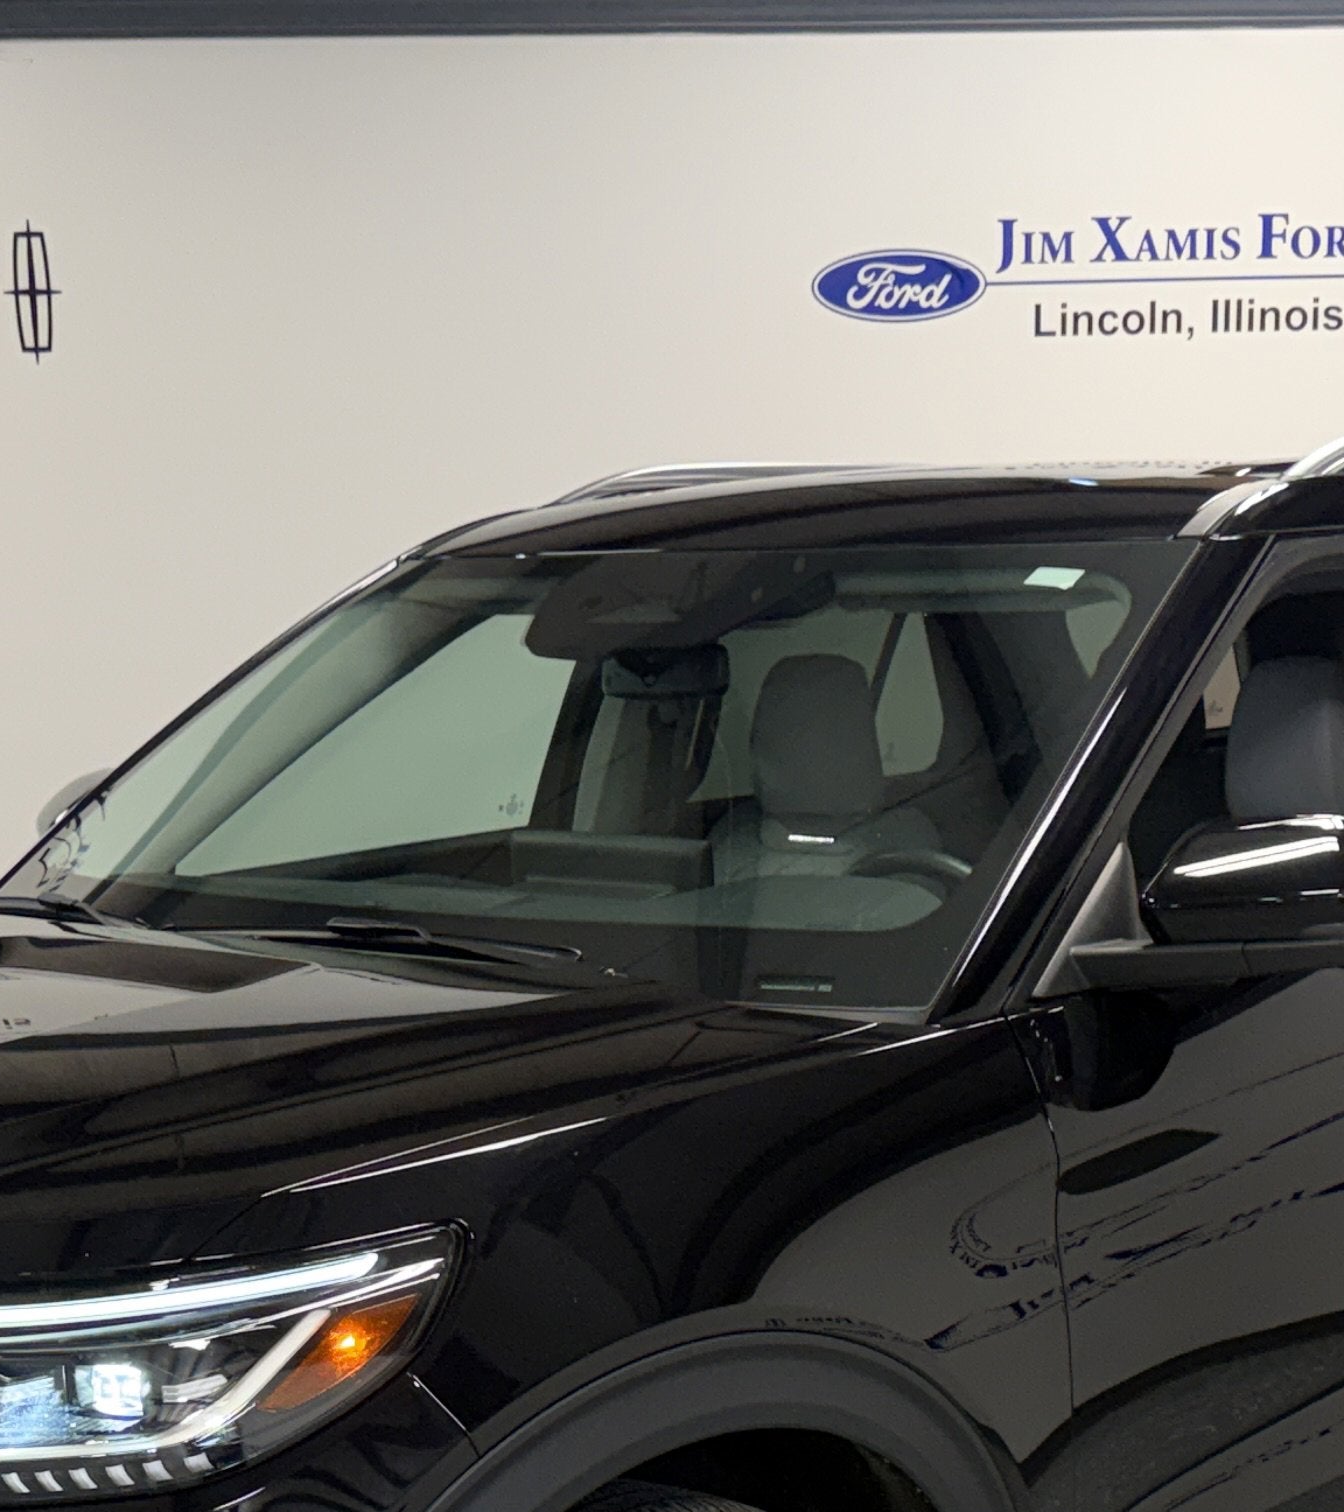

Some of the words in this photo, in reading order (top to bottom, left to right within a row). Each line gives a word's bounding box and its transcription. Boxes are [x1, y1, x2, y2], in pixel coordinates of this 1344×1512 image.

[846, 261, 950, 310] Ford
[1034, 300, 1194, 341] Lincoln,
[1211, 297, 1344, 333] Illinois
